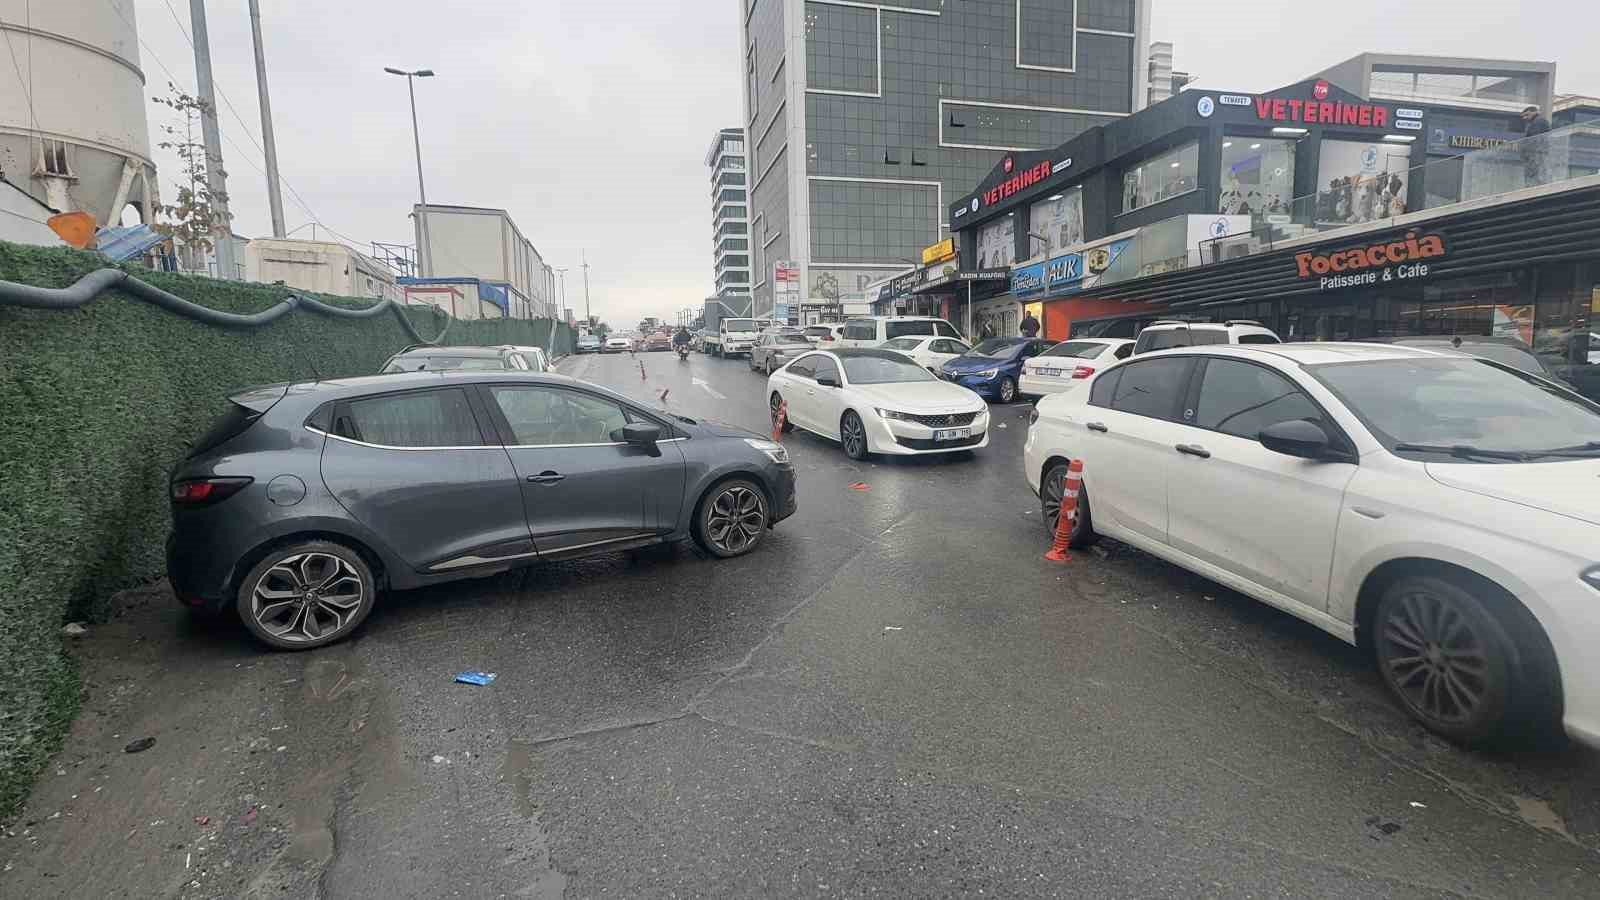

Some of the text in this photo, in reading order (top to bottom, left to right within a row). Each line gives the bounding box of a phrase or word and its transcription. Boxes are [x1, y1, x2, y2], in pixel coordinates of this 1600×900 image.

[1255, 97, 1388, 127] VETERİNER
[983, 160, 1051, 206] VETERİNER
[1295, 230, 1445, 277] Focaccia
[1320, 262, 1428, 290] Patisserie & Cafe
